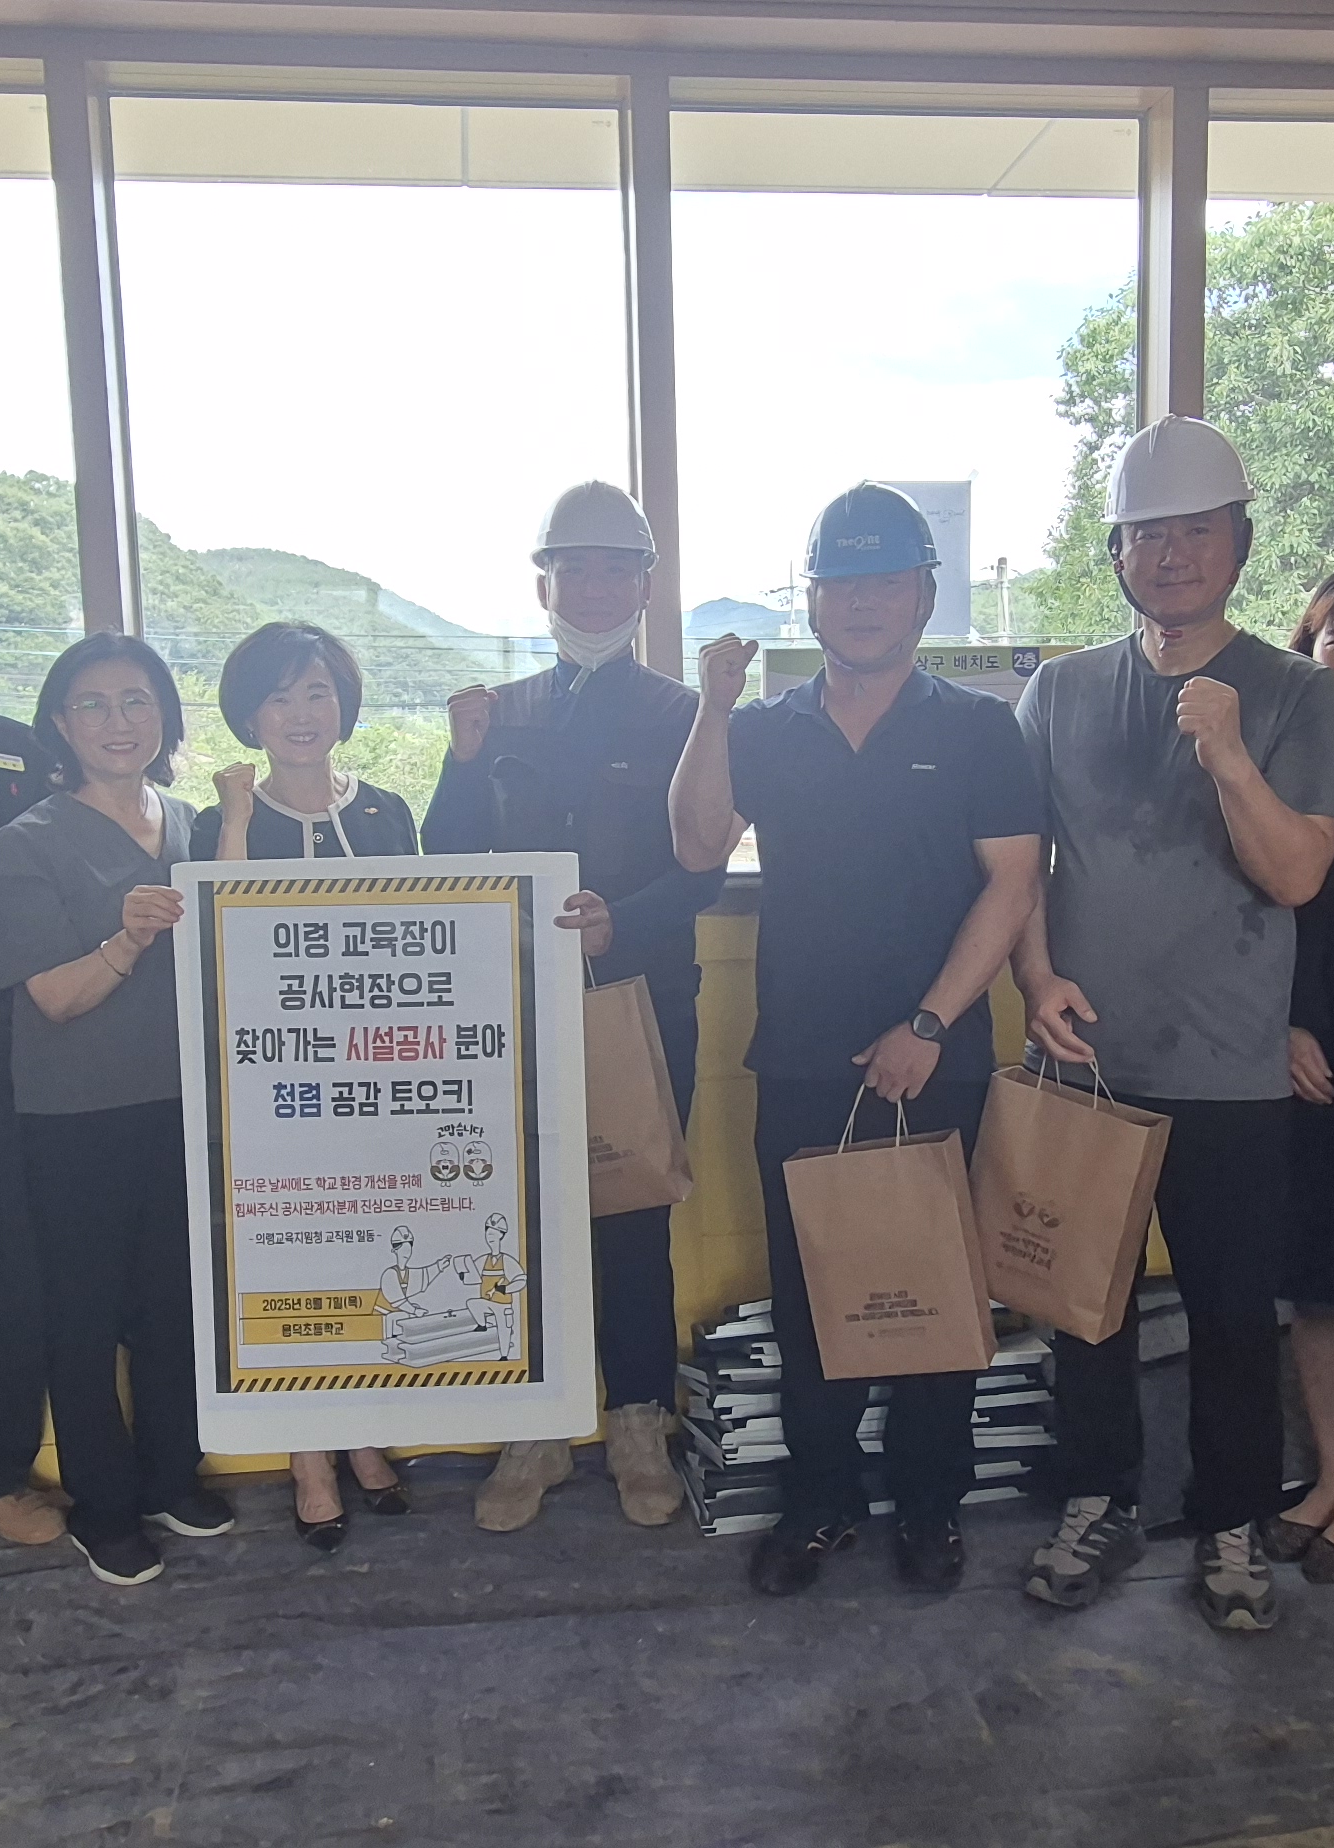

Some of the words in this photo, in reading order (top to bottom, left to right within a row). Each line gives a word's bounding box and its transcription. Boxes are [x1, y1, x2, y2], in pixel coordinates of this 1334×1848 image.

[953, 655, 1000, 670] 배치도
[1013, 652, 1037, 669] 2층
[273, 922, 330, 958] 의령
[341, 919, 456, 957] 교육장이
[278, 971, 455, 1010] 공사현장으로
[235, 1027, 336, 1064] 찾아가는
[346, 1025, 446, 1061] 시설공사
[455, 1023, 505, 1060] 분야
[272, 1081, 321, 1118] 청렴
[331, 1081, 381, 1116] 공감
[390, 1079, 473, 1115] 토오크!
[436, 1122, 485, 1139] 고맙습니다
[234, 1177, 266, 1193] 무더운
[268, 1176, 313, 1192] 날씨에도
[316, 1176, 337, 1191] 학교
[339, 1175, 362, 1190] 환경
[365, 1174, 398, 1190] 개선을
[399, 1173, 422, 1188] 위해
[281, 1200, 358, 1216] 공사관계자분께
[361, 1198, 405, 1214] 진심으로
[407, 1196, 476, 1213] 감사드립니다.
[325, 1229, 354, 1244] 교직원
[356, 1229, 375, 1243] 일동
[263, 1298, 302, 1312] 2025년
